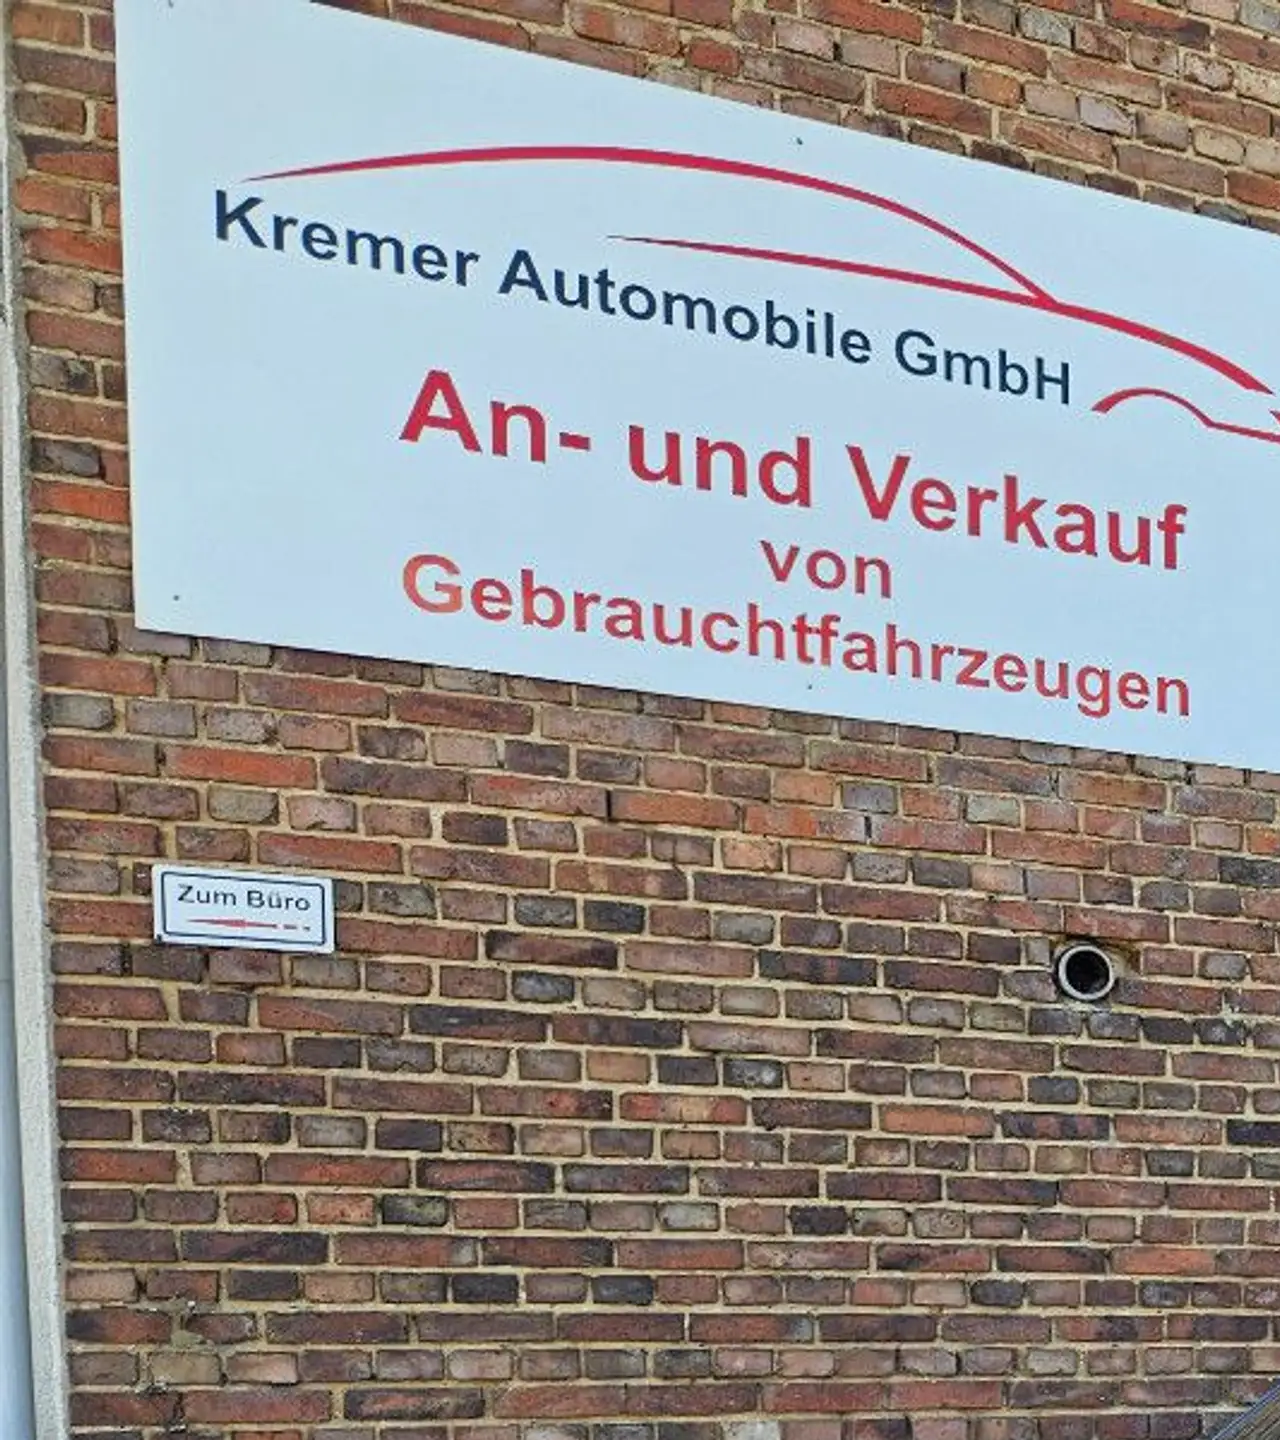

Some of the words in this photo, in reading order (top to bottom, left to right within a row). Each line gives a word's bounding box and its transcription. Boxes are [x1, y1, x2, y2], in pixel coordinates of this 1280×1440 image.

[214, 188, 482, 288] Kremer
[498, 248, 873, 365] Automobile
[893, 328, 1071, 407] GmbH
[400, 369, 590, 464] An-
[627, 426, 812, 507] und
[846, 444, 1188, 570] Verkauf
[402, 553, 1191, 719] Gebrauchtfahrzeugen
[760, 539, 893, 599] von
[177, 883, 237, 906] Zum
[246, 889, 311, 912] Büro
